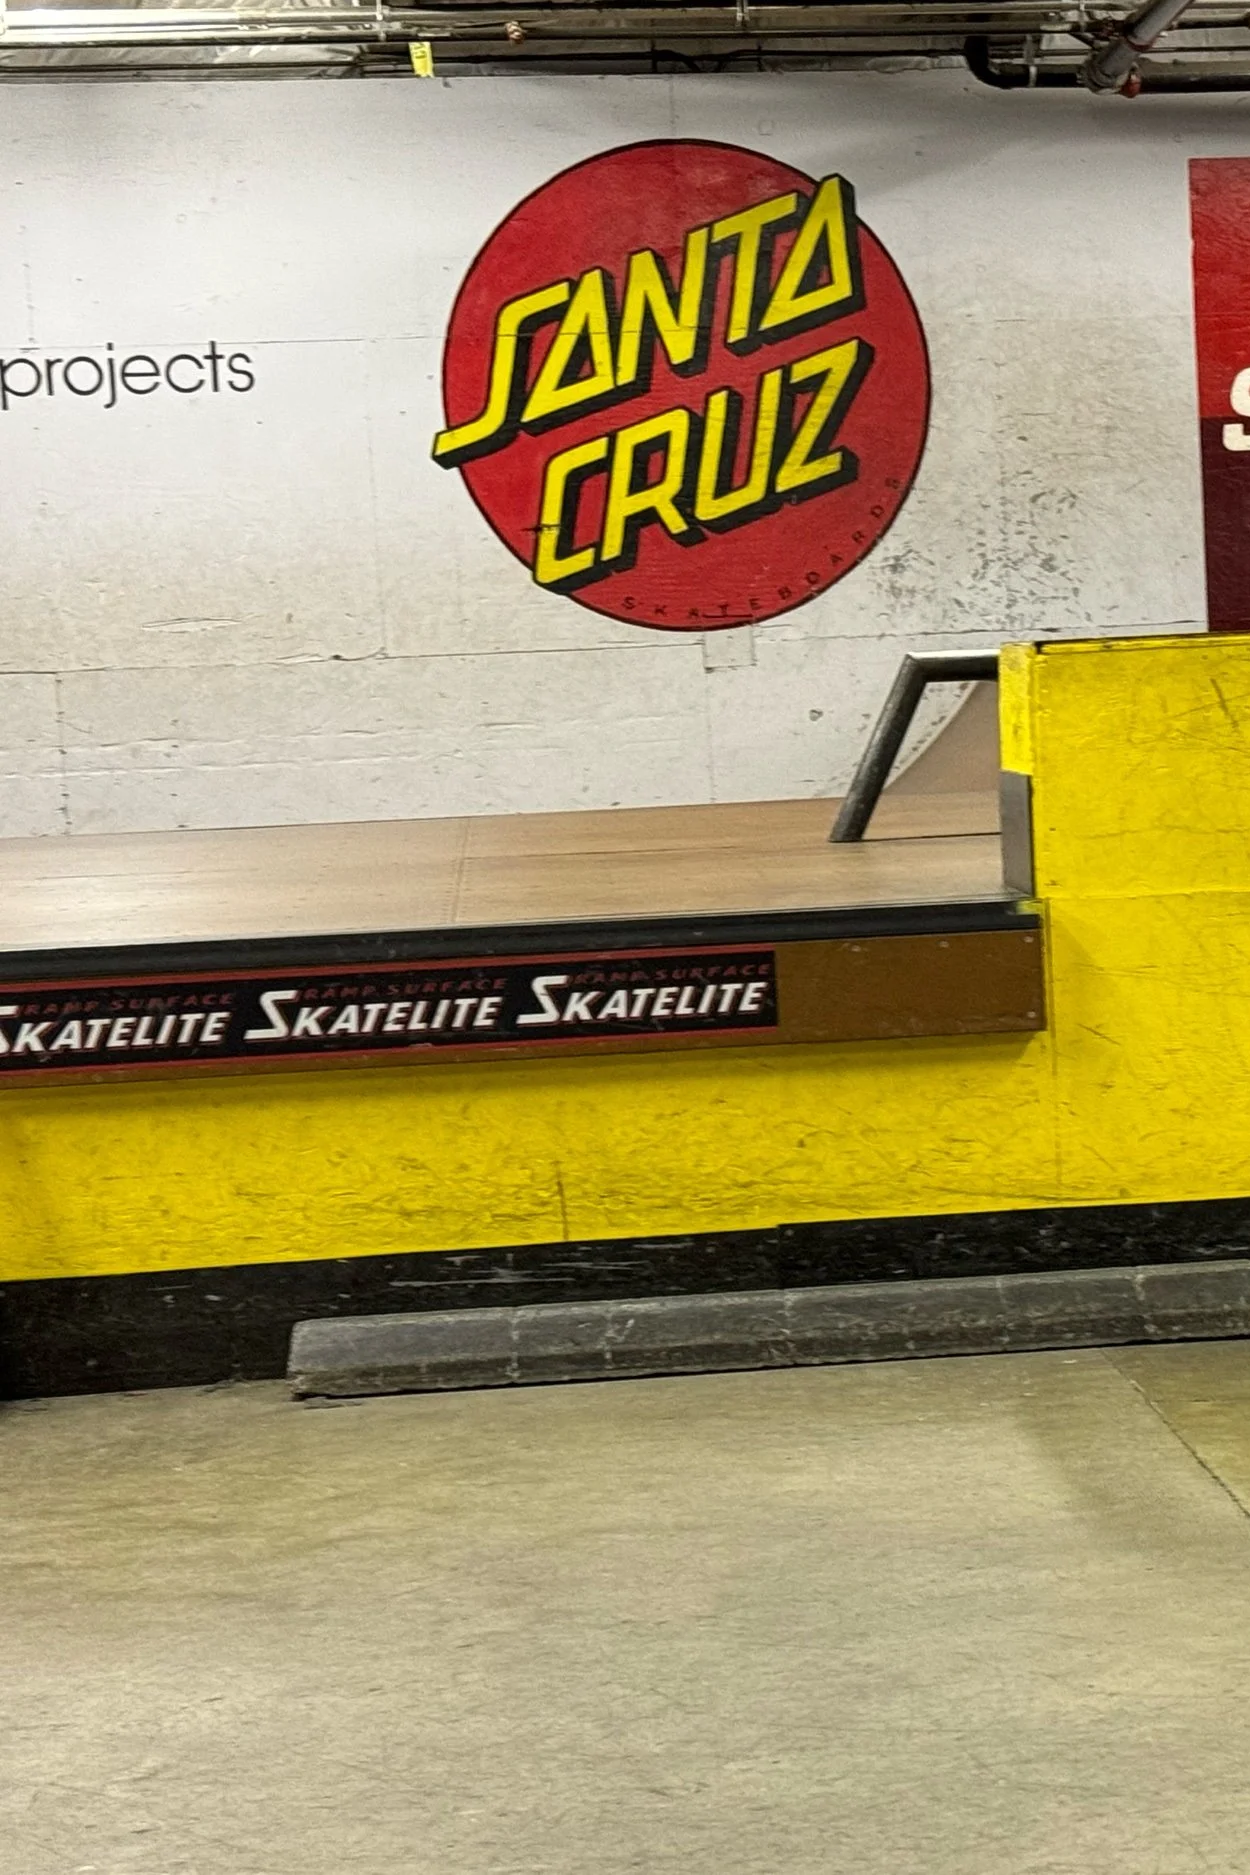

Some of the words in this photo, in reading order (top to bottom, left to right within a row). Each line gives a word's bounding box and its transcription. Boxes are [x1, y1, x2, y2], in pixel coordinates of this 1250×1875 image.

[432, 174, 864, 468] SANTA
[0, 341, 255, 410] projects
[534, 337, 872, 592] CRUZ
[621, 476, 903, 618] SKATEBOARDS
[243, 990, 503, 1041] SKATELITE
[516, 975, 768, 1025] SKATELITE
